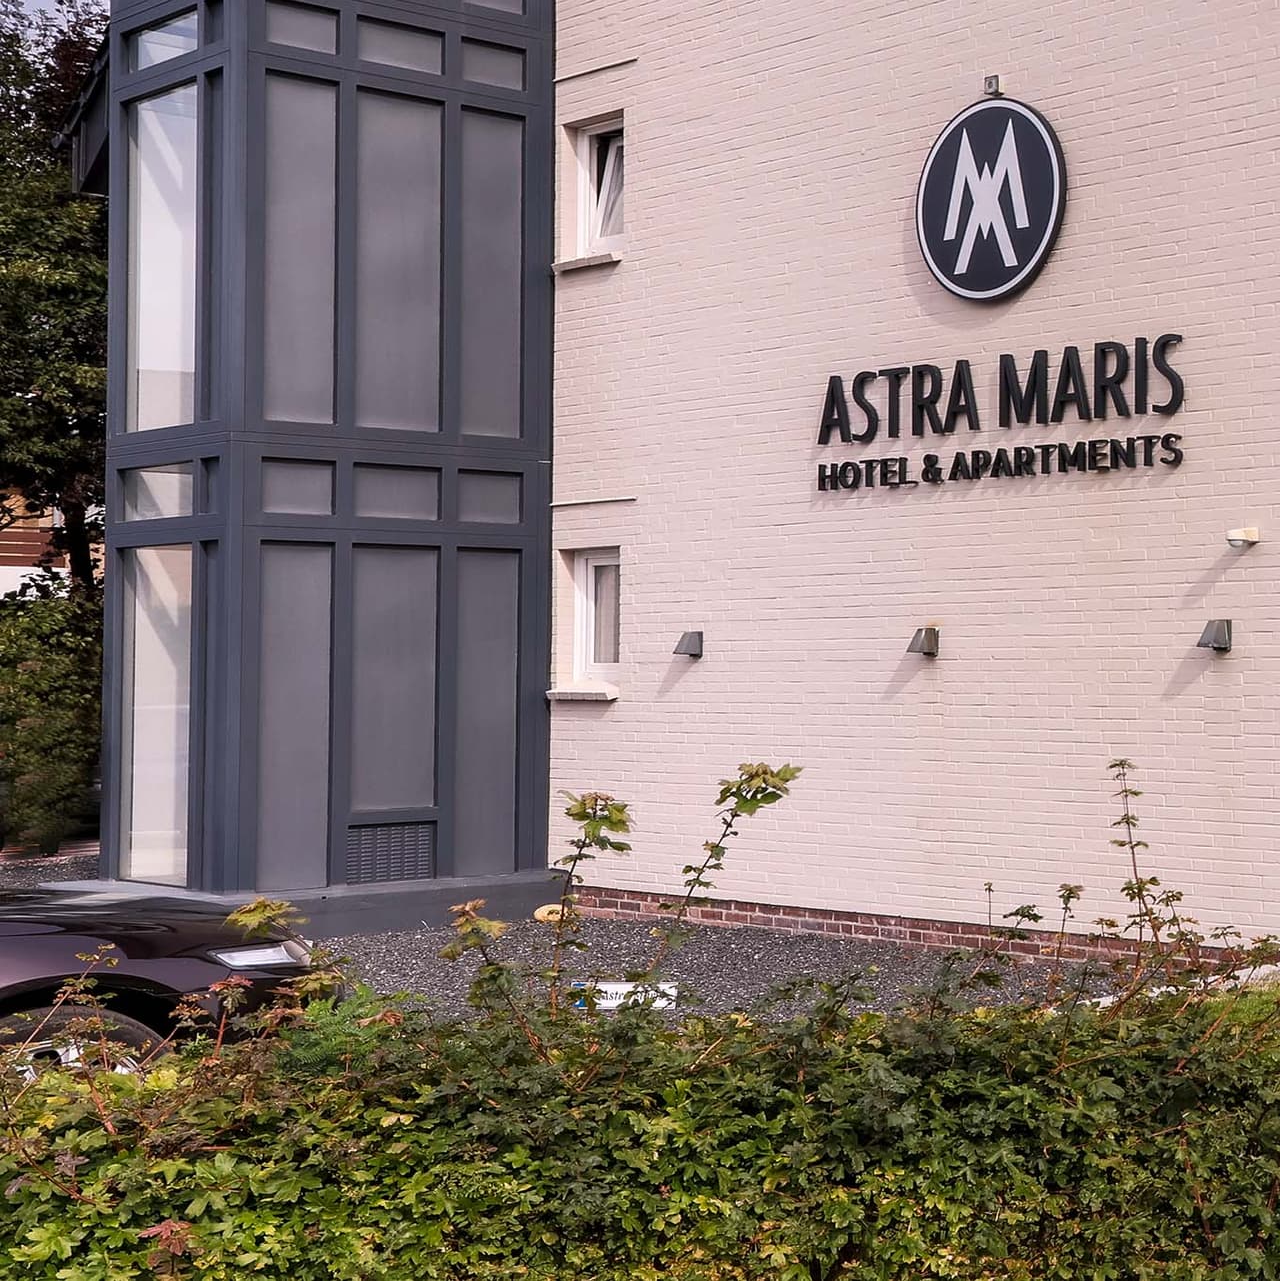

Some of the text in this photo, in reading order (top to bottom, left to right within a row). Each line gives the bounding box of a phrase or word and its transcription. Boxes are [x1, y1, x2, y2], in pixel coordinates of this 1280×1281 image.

[816, 333, 1185, 446] ASTRA MARIS
[817, 433, 1184, 491] HOTEL & APARTMENTS
